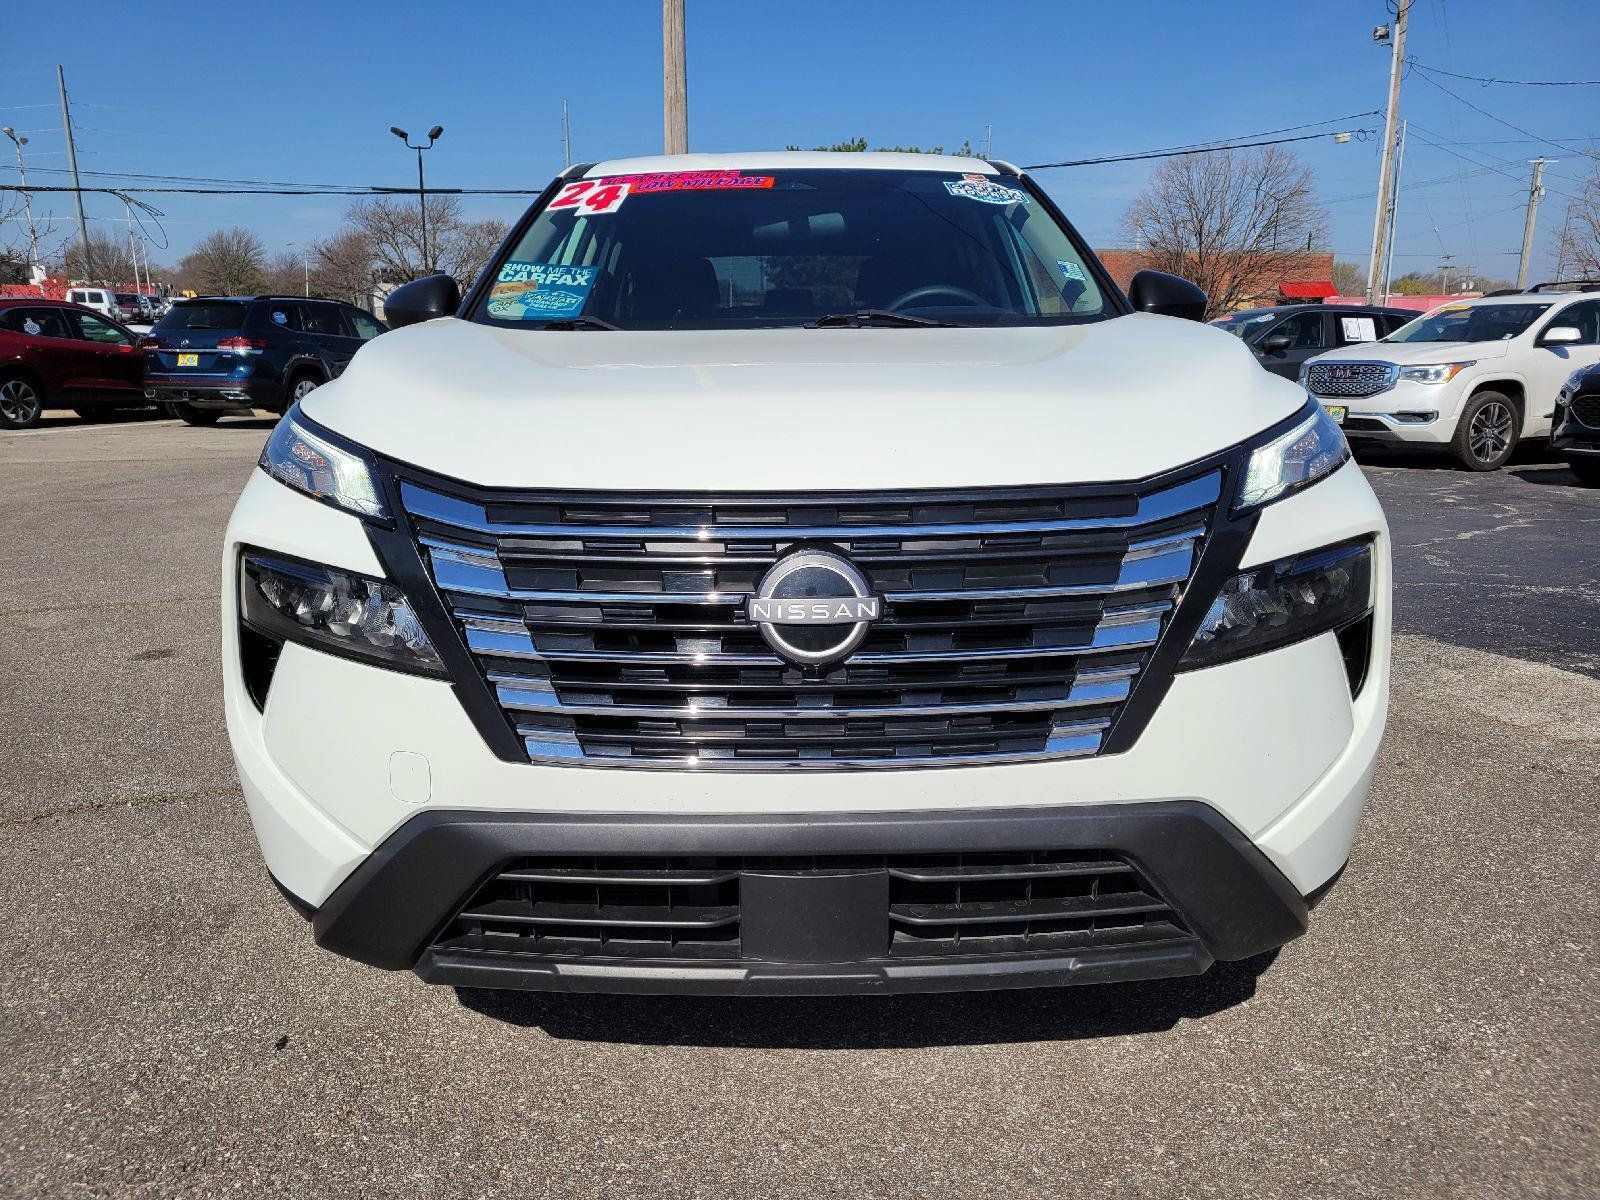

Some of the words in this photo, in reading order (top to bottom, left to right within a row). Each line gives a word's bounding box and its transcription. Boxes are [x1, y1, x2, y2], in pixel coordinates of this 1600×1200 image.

[636, 180, 676, 191] LOW
[680, 177, 767, 188] MILEAGE
[550, 182, 623, 211] 24
[499, 269, 591, 286] CARFAX
[503, 263, 545, 272] SHOW
[547, 267, 568, 275] ME
[570, 267, 593, 275] THE
[753, 601, 876, 619] NISSAN
